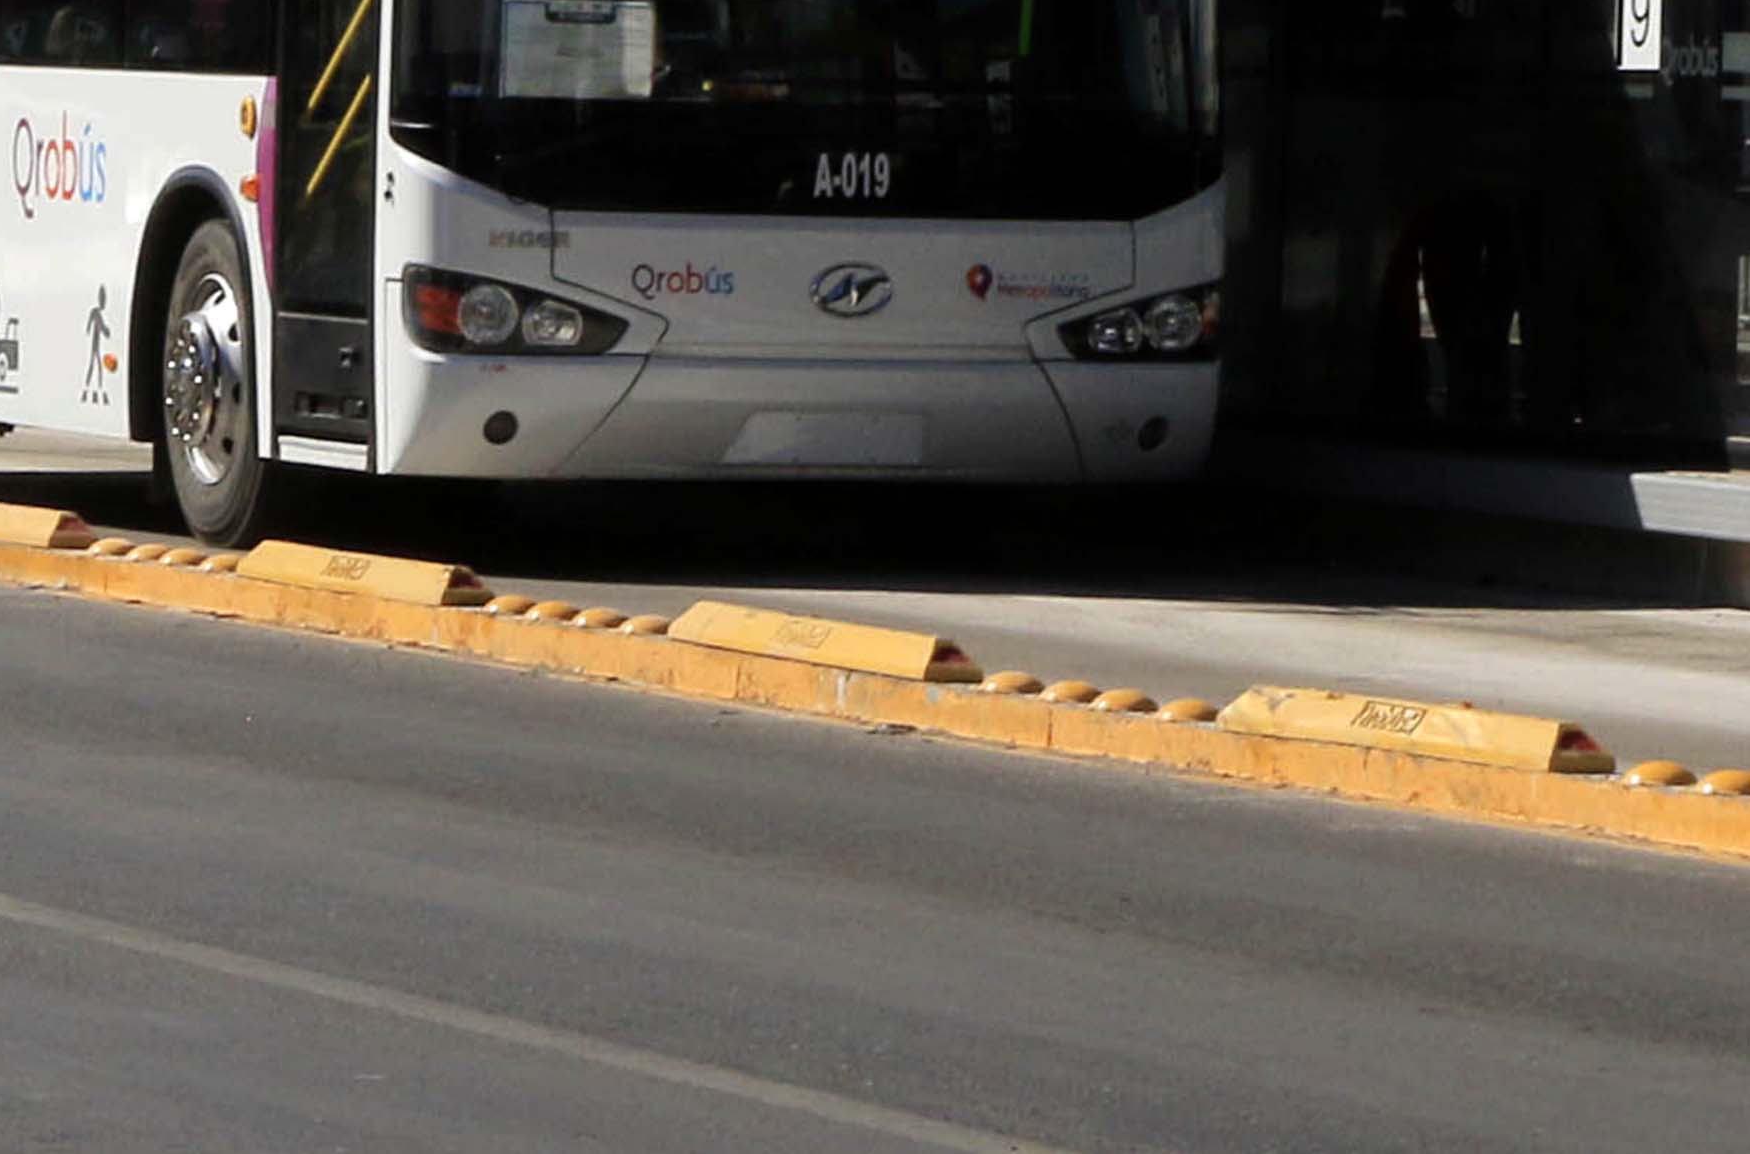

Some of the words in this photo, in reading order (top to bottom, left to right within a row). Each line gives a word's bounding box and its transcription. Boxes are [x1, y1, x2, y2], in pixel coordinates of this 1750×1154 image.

[13, 109, 107, 220] Qrobús
[813, 151, 891, 199] A-019
[631, 262, 735, 301] Qrobús
